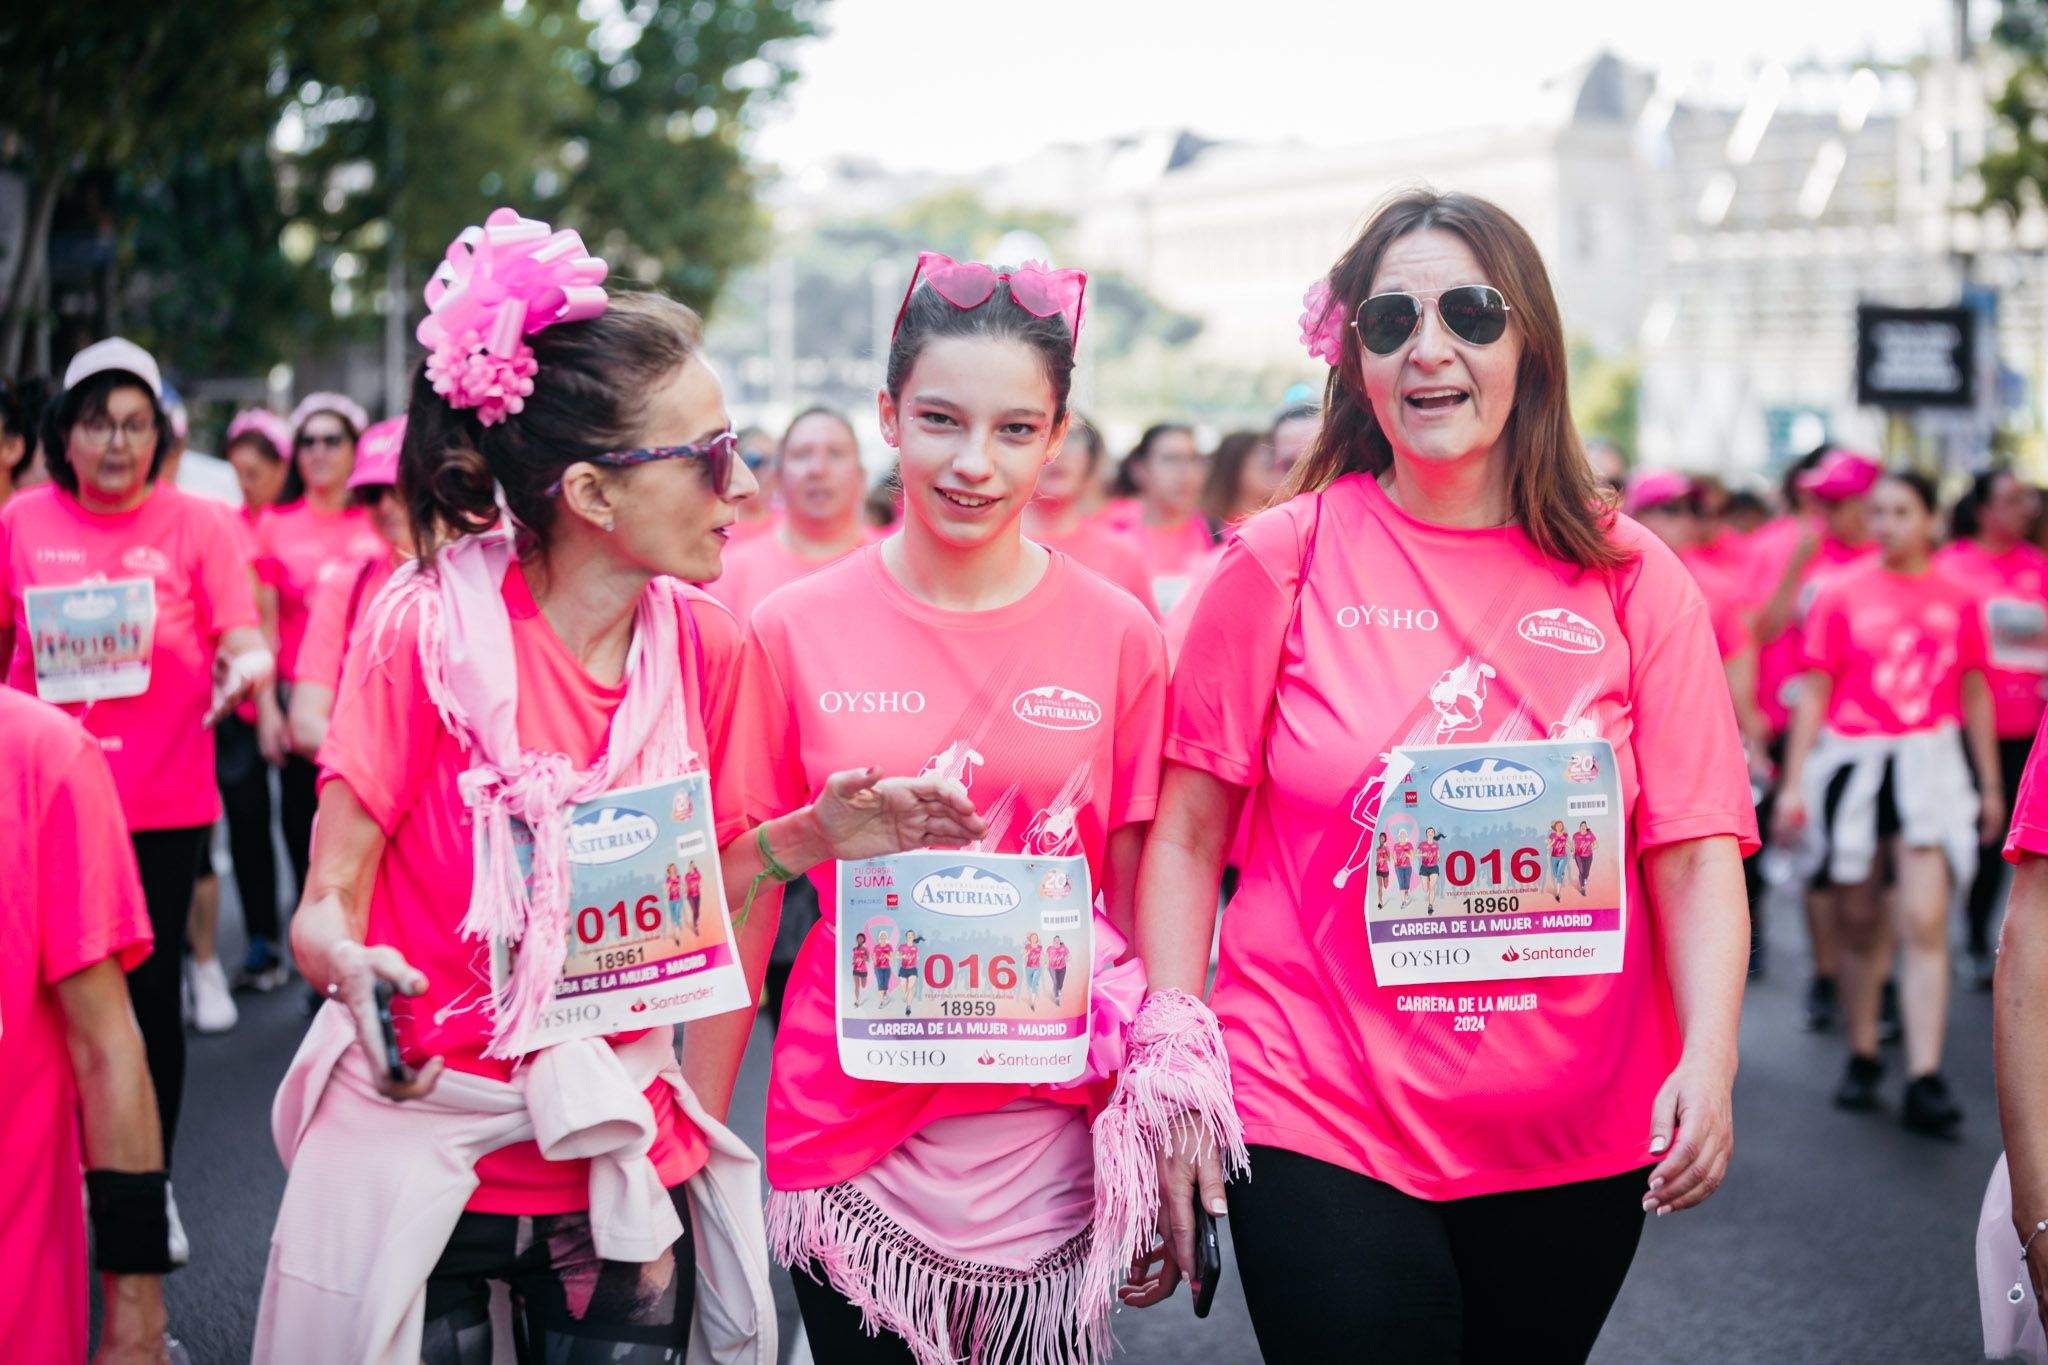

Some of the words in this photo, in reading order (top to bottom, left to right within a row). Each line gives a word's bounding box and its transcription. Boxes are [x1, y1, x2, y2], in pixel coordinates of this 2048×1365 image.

[1336, 605, 1439, 631] OYSHO
[1526, 620, 1600, 649] ASTURIANA
[819, 690, 926, 713] OYSHO
[1021, 699, 1095, 722] ASTURIANA
[1440, 779, 1538, 799] ASTURIANA
[1445, 847, 1542, 887] 016
[854, 875, 894, 888] SUMA
[920, 883, 1014, 906] ASTURIANA
[1463, 896, 1519, 914] 18960
[576, 895, 661, 944] 016
[1392, 921, 1447, 937] CARRERA
[1451, 920, 1468, 934] DE
[1471, 919, 1487, 933] LA
[1490, 916, 1532, 932] MUJER
[1543, 914, 1592, 928] MADRID
[595, 946, 645, 971] 18961
[1391, 947, 1470, 969] OYSHO
[1522, 945, 1596, 961] Santander
[582, 976, 600, 992] DE
[601, 974, 617, 990] LA
[619, 966, 660, 985] MUJER
[923, 954, 1018, 990] 016
[649, 985, 715, 1012] Santander
[940, 1000, 996, 1016] 18959
[1397, 995, 1455, 1013] CARRERA
[1458, 996, 1475, 1013] DE
[1478, 995, 1494, 1012] LA
[1497, 993, 1538, 1011] MUJER
[868, 1022, 924, 1036] CARRERA
[928, 1022, 944, 1035] DE
[947, 1022, 964, 1035] LA
[967, 1022, 1008, 1036] MUJER
[1018, 1023, 1067, 1036] MADRID
[1454, 1015, 1485, 1032] 2024
[867, 1049, 946, 1067] OYSHO
[998, 1053, 1072, 1067] Santander
